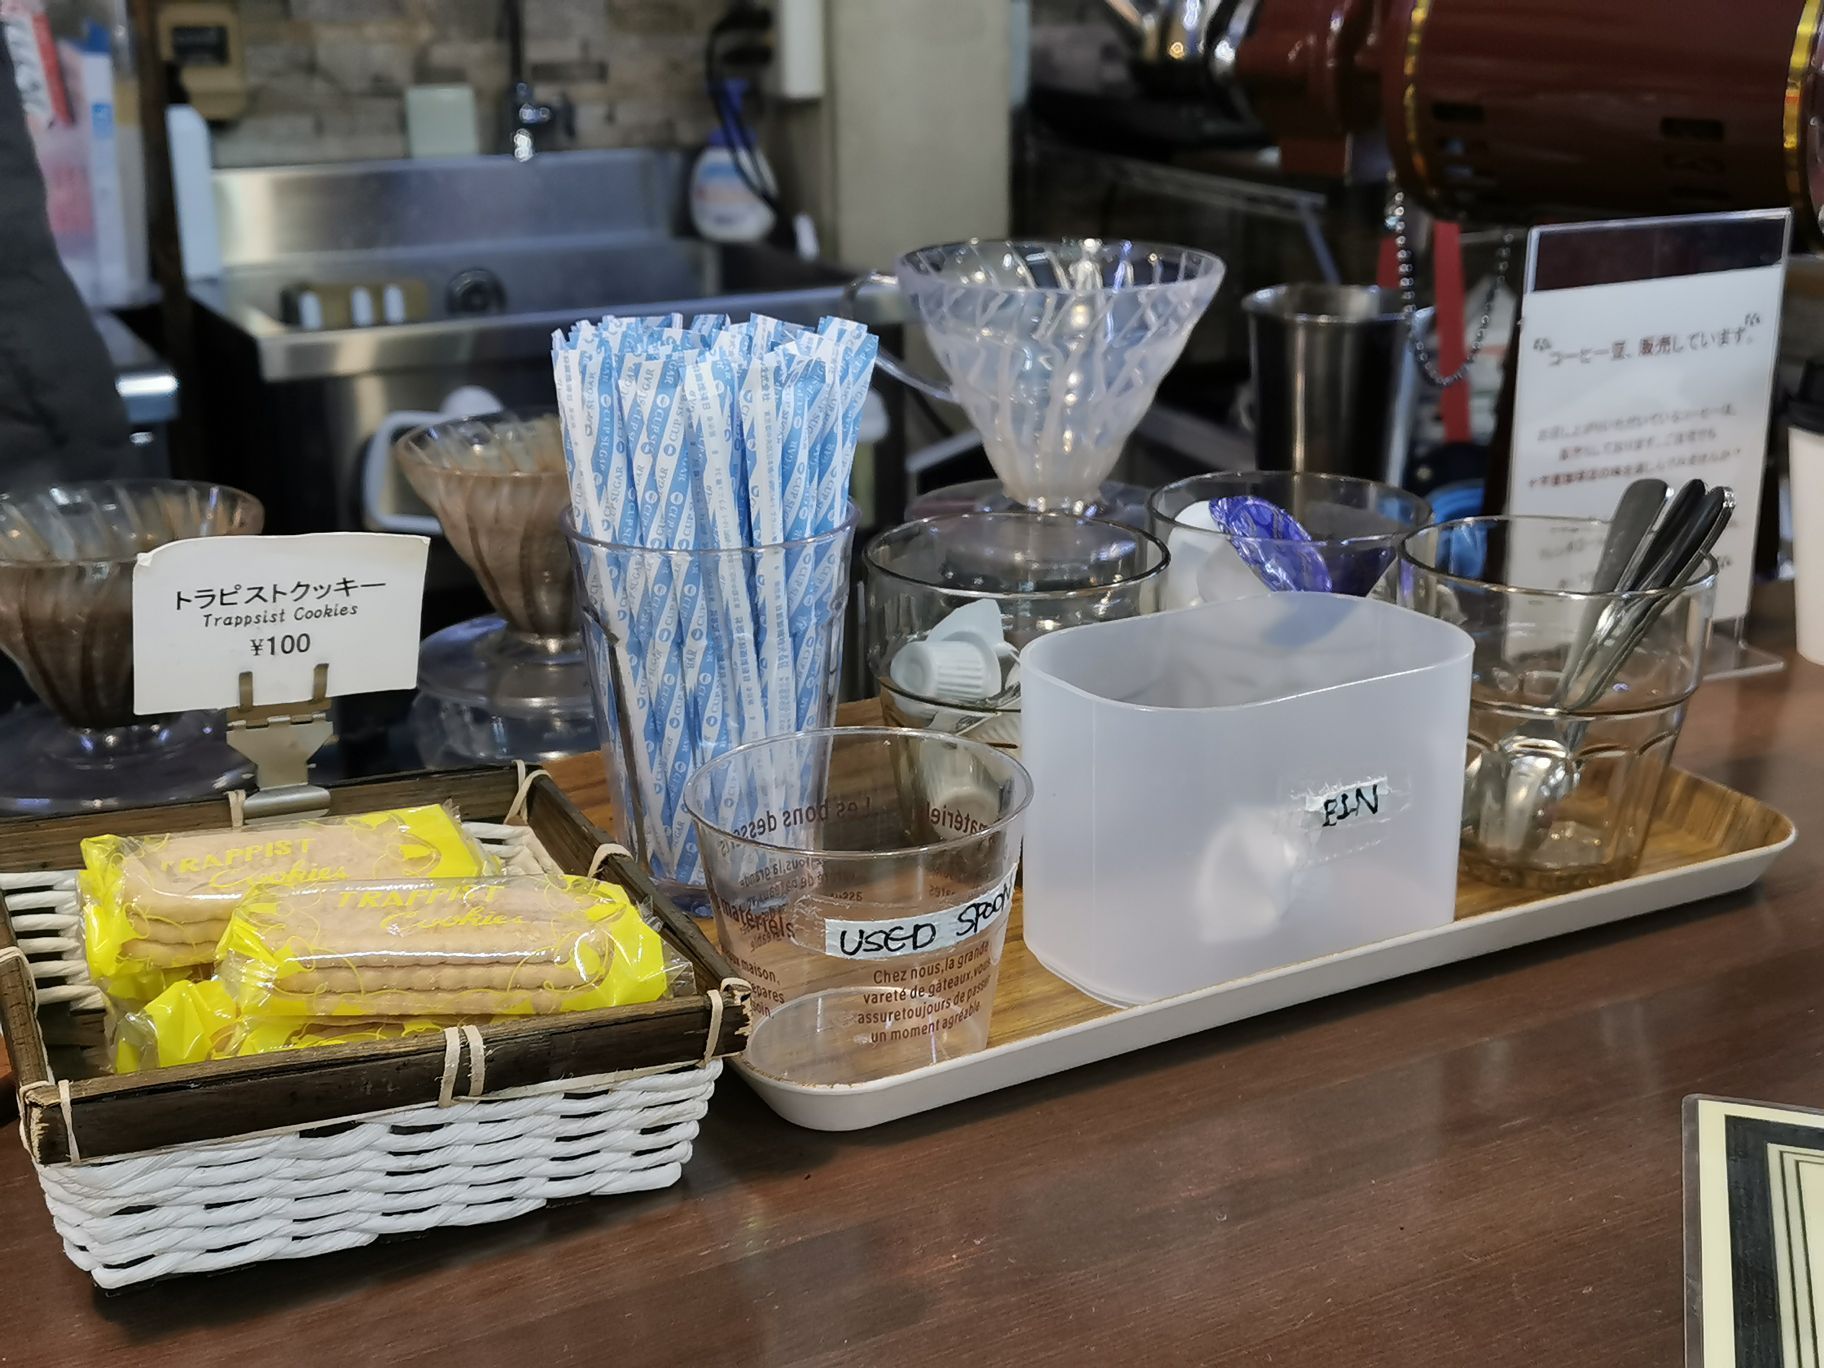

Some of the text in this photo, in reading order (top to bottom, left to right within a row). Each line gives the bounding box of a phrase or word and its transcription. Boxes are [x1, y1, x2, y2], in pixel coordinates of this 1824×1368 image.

[175, 577, 387, 610] トラピストクッキー
[203, 603, 359, 628] Trappsist Cookies
[250, 632, 311, 657] ¥100
[160, 838, 317, 874] TRAPPIST
[840, 923, 937, 956] USED
[873, 969, 908, 985] Chez
[957, 940, 990, 970] grande
[863, 988, 907, 1004] vareté
[910, 984, 925, 999] de
[953, 990, 966, 1006] de
[871, 1031, 887, 1043] un
[890, 1020, 940, 1040] moment
